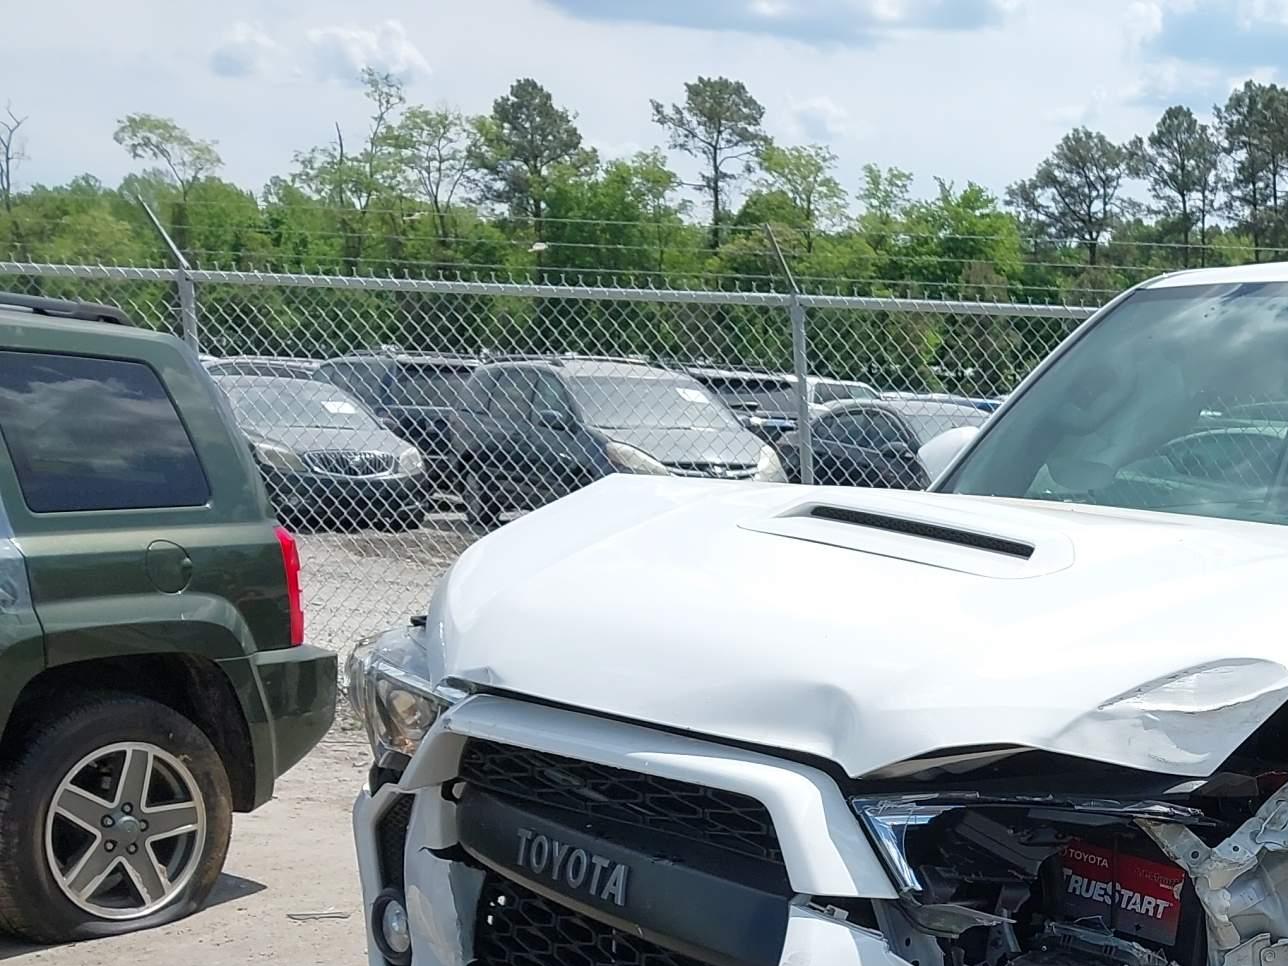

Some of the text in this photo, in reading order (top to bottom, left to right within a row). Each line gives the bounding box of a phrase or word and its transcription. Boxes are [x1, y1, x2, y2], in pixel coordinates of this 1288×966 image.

[517, 828, 628, 907] TOYOTA
[1069, 849, 1109, 868] TOYOTA
[1062, 868, 1169, 919] TRUESTART
